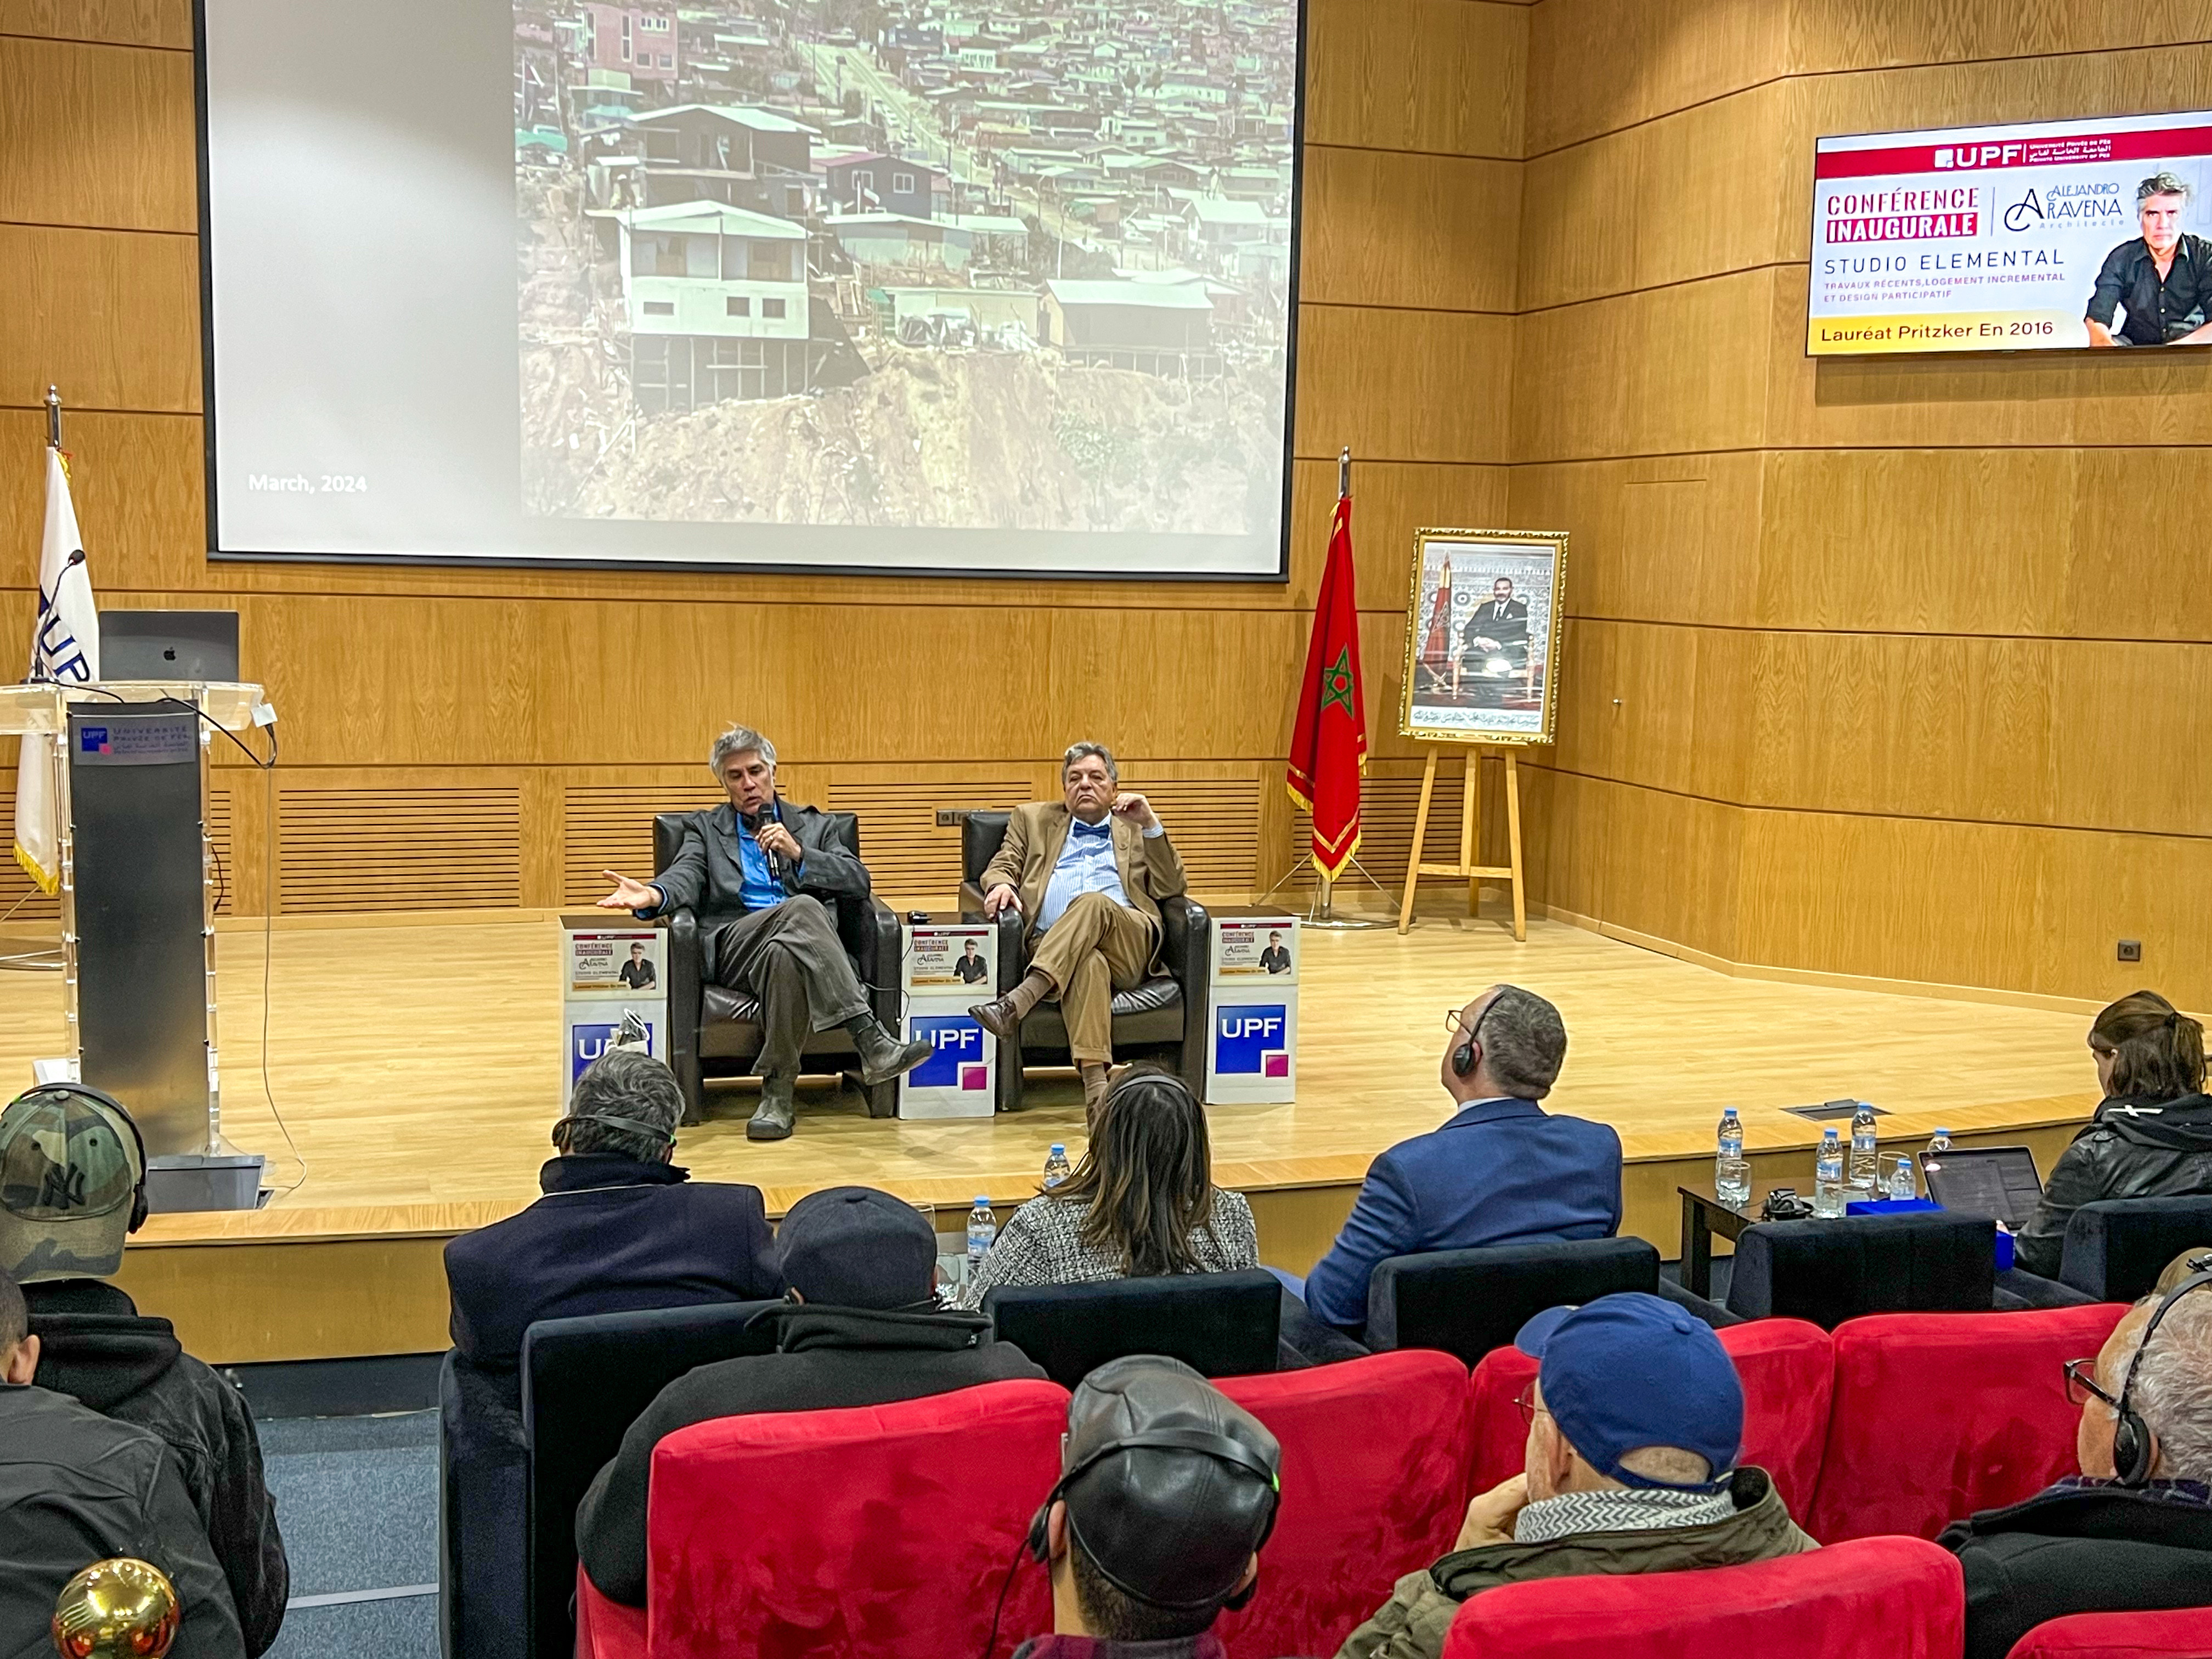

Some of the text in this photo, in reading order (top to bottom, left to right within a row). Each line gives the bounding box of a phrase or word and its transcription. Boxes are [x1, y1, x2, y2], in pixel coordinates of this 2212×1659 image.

[1956, 144, 2023, 167] UPF
[1828, 187, 1979, 215] CONFÉRENCE
[2046, 183, 2120, 201] ALEJANDRO
[1829, 214, 1974, 242] INAUGURALE
[1825, 249, 2064, 274] STUDIO ELEMENTAL
[1825, 281, 1870, 290] TRAVAUX
[1987, 273, 2065, 283] INCREMENTAL
[1839, 293, 1878, 302] DESIGN
[1882, 290, 1951, 300] PARTICIPATIF
[1821, 321, 2053, 341] Lauréat Pritzker En 2016
[249, 474, 367, 494] March, 2024
[40, 613, 90, 681] UP
[1222, 1017, 1282, 1038] UPF
